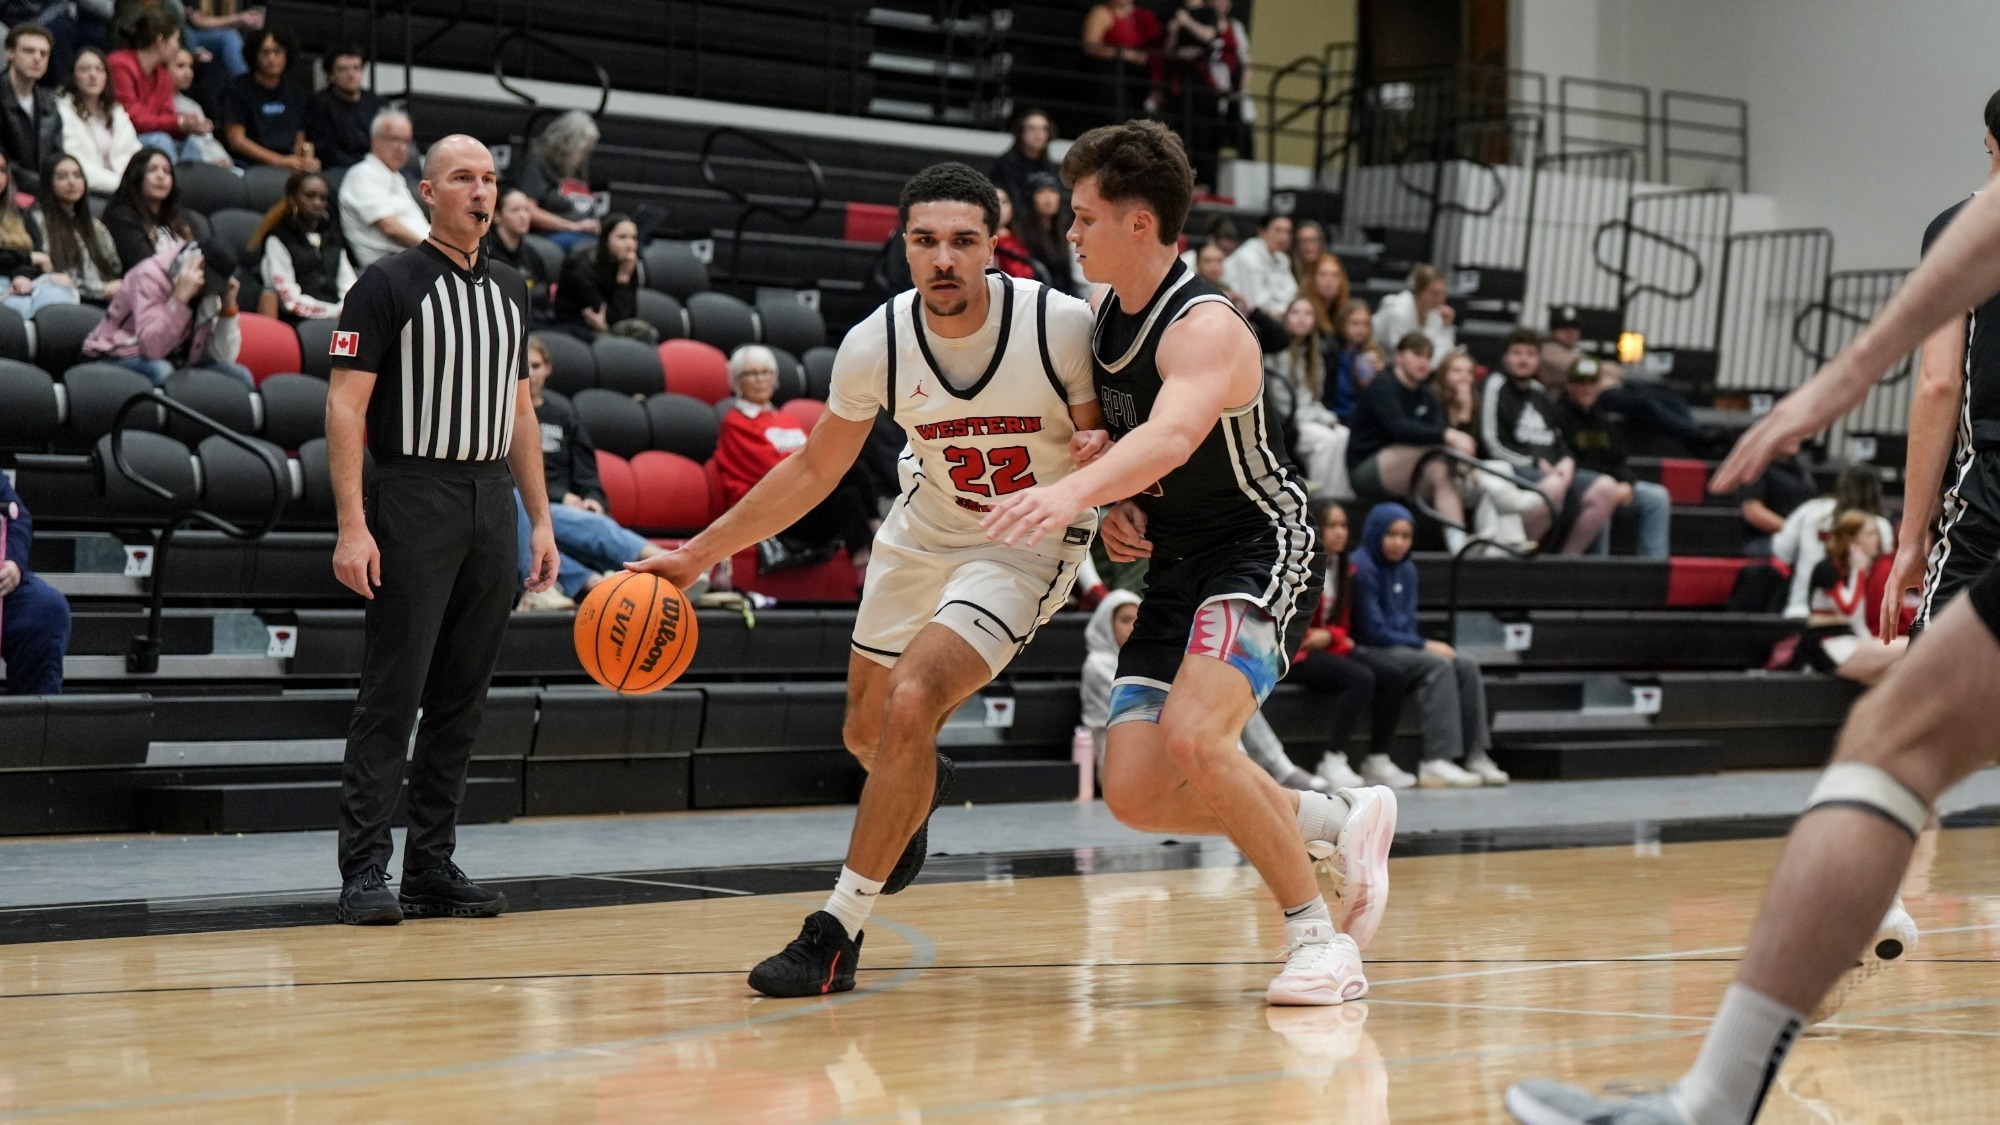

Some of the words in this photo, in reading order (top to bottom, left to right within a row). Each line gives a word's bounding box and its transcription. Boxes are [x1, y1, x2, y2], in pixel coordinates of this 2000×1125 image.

[914, 415, 1041, 440] WESTERN
[1101, 386, 1138, 429] SPU
[943, 445, 1037, 497] 22
[610, 597, 635, 647] EVO
[638, 597, 679, 672] Wilson
